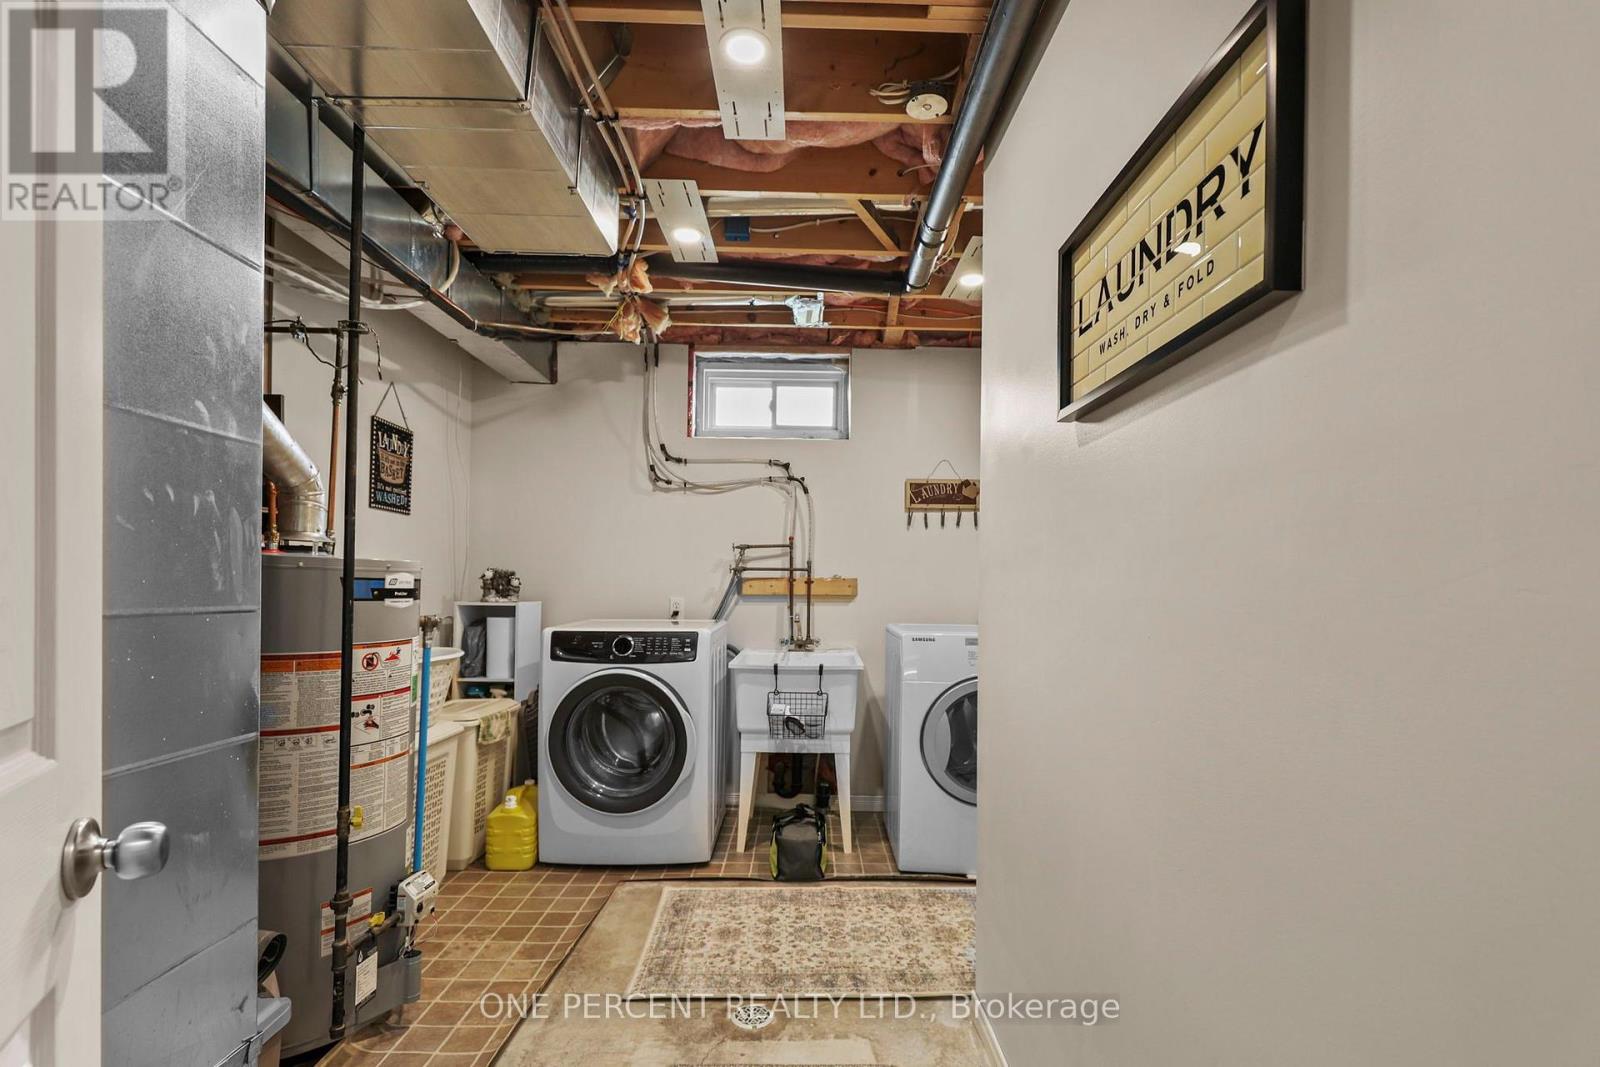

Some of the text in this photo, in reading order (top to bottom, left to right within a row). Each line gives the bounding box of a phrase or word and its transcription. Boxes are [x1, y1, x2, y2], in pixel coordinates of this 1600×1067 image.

[1078, 120, 1266, 338] LAUNDRY
[1135, 302, 1156, 330] DRY
[1163, 293, 1170, 308] &
[1178, 259, 1214, 298] FOLD
[910, 483, 959, 503] LAUNDRY
